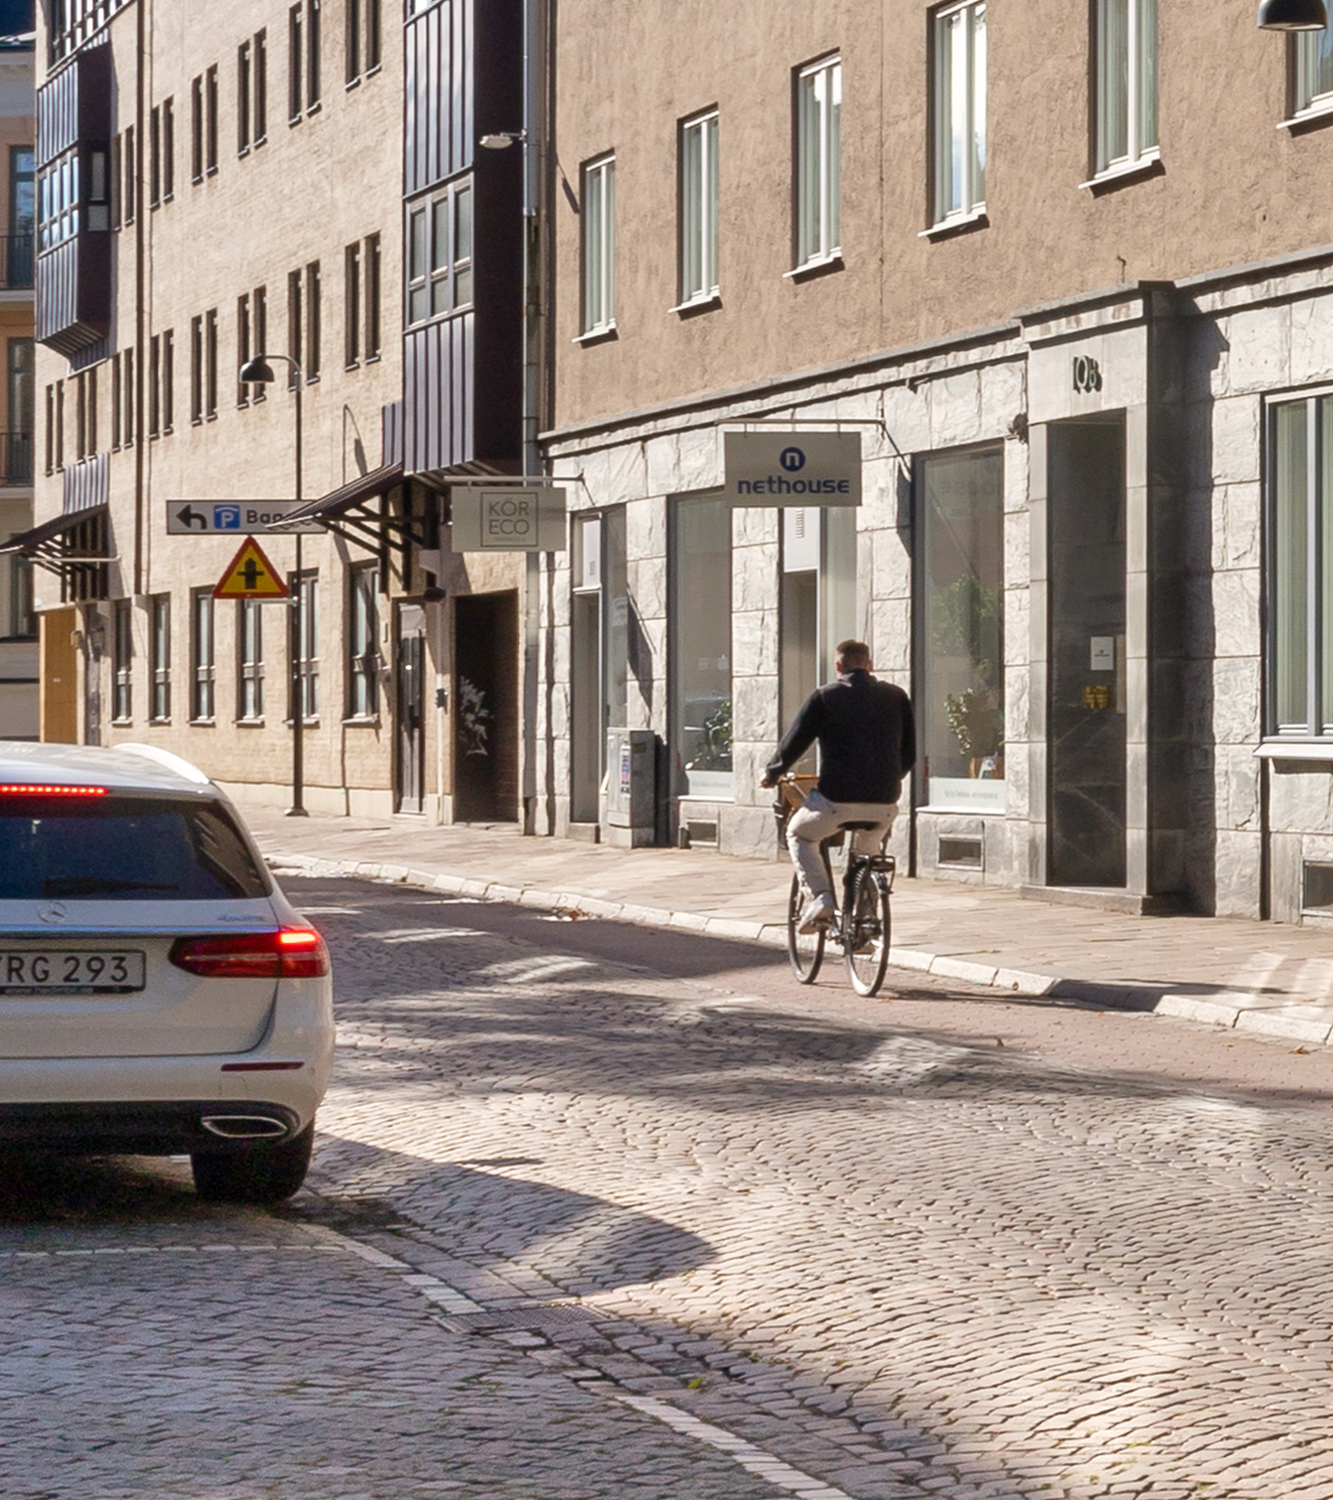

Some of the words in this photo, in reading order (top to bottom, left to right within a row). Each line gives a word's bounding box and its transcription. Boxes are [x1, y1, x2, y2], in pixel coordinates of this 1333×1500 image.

[737, 475, 850, 494] nethouse
[489, 496, 529, 516] KÖR
[489, 519, 530, 535] ECO
[0, 955, 50, 983] RG
[63, 955, 128, 983] 293
